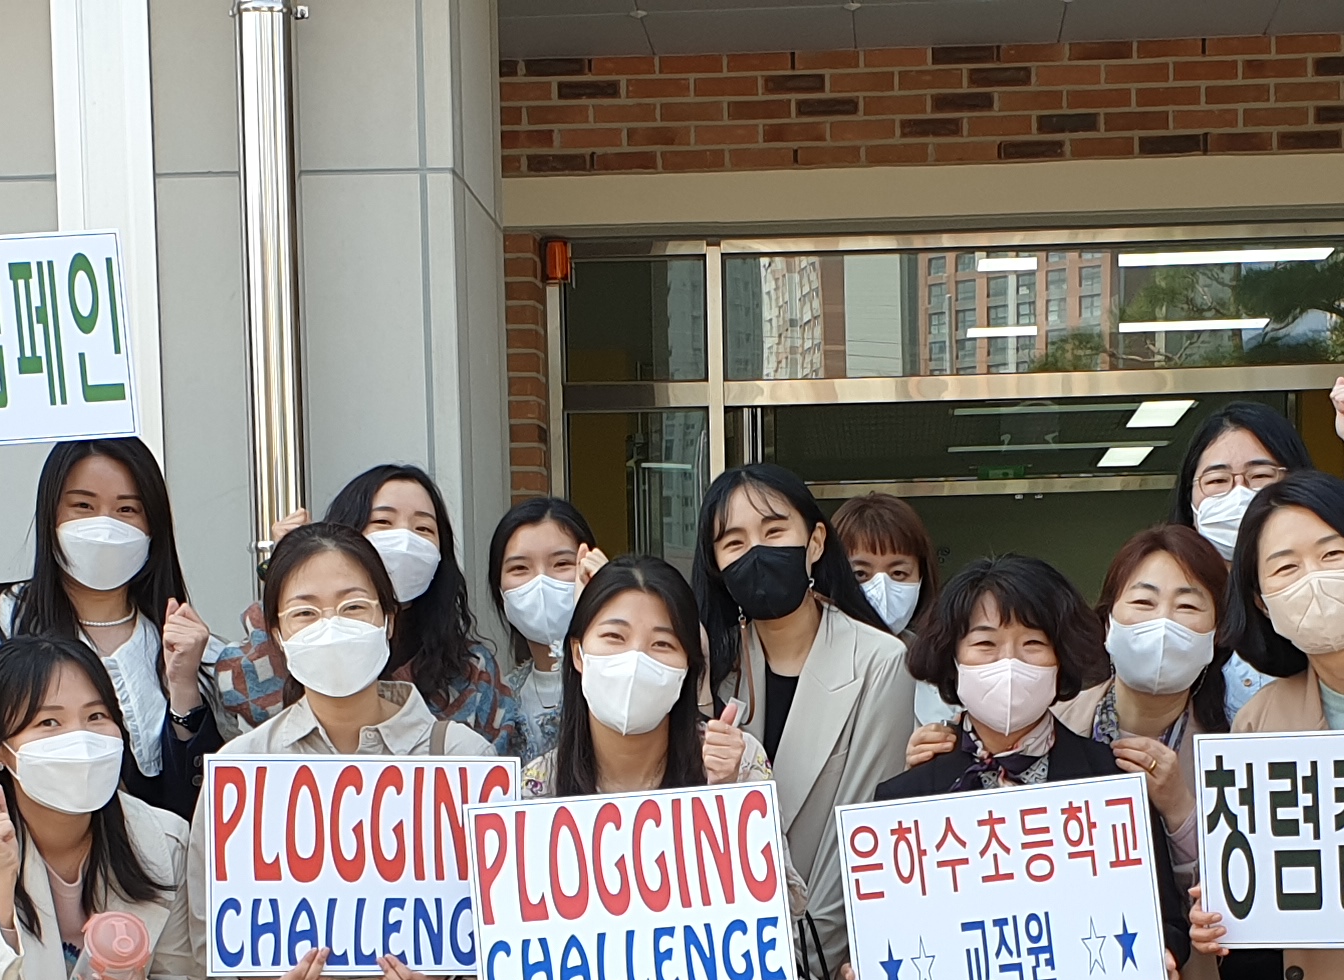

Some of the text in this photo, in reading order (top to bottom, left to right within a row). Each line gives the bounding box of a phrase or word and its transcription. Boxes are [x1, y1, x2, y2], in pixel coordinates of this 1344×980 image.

[474, 790, 777, 925] PLOGGING
[849, 797, 1142, 900] 은하수초등학교
[215, 897, 476, 967] CHALLENG
